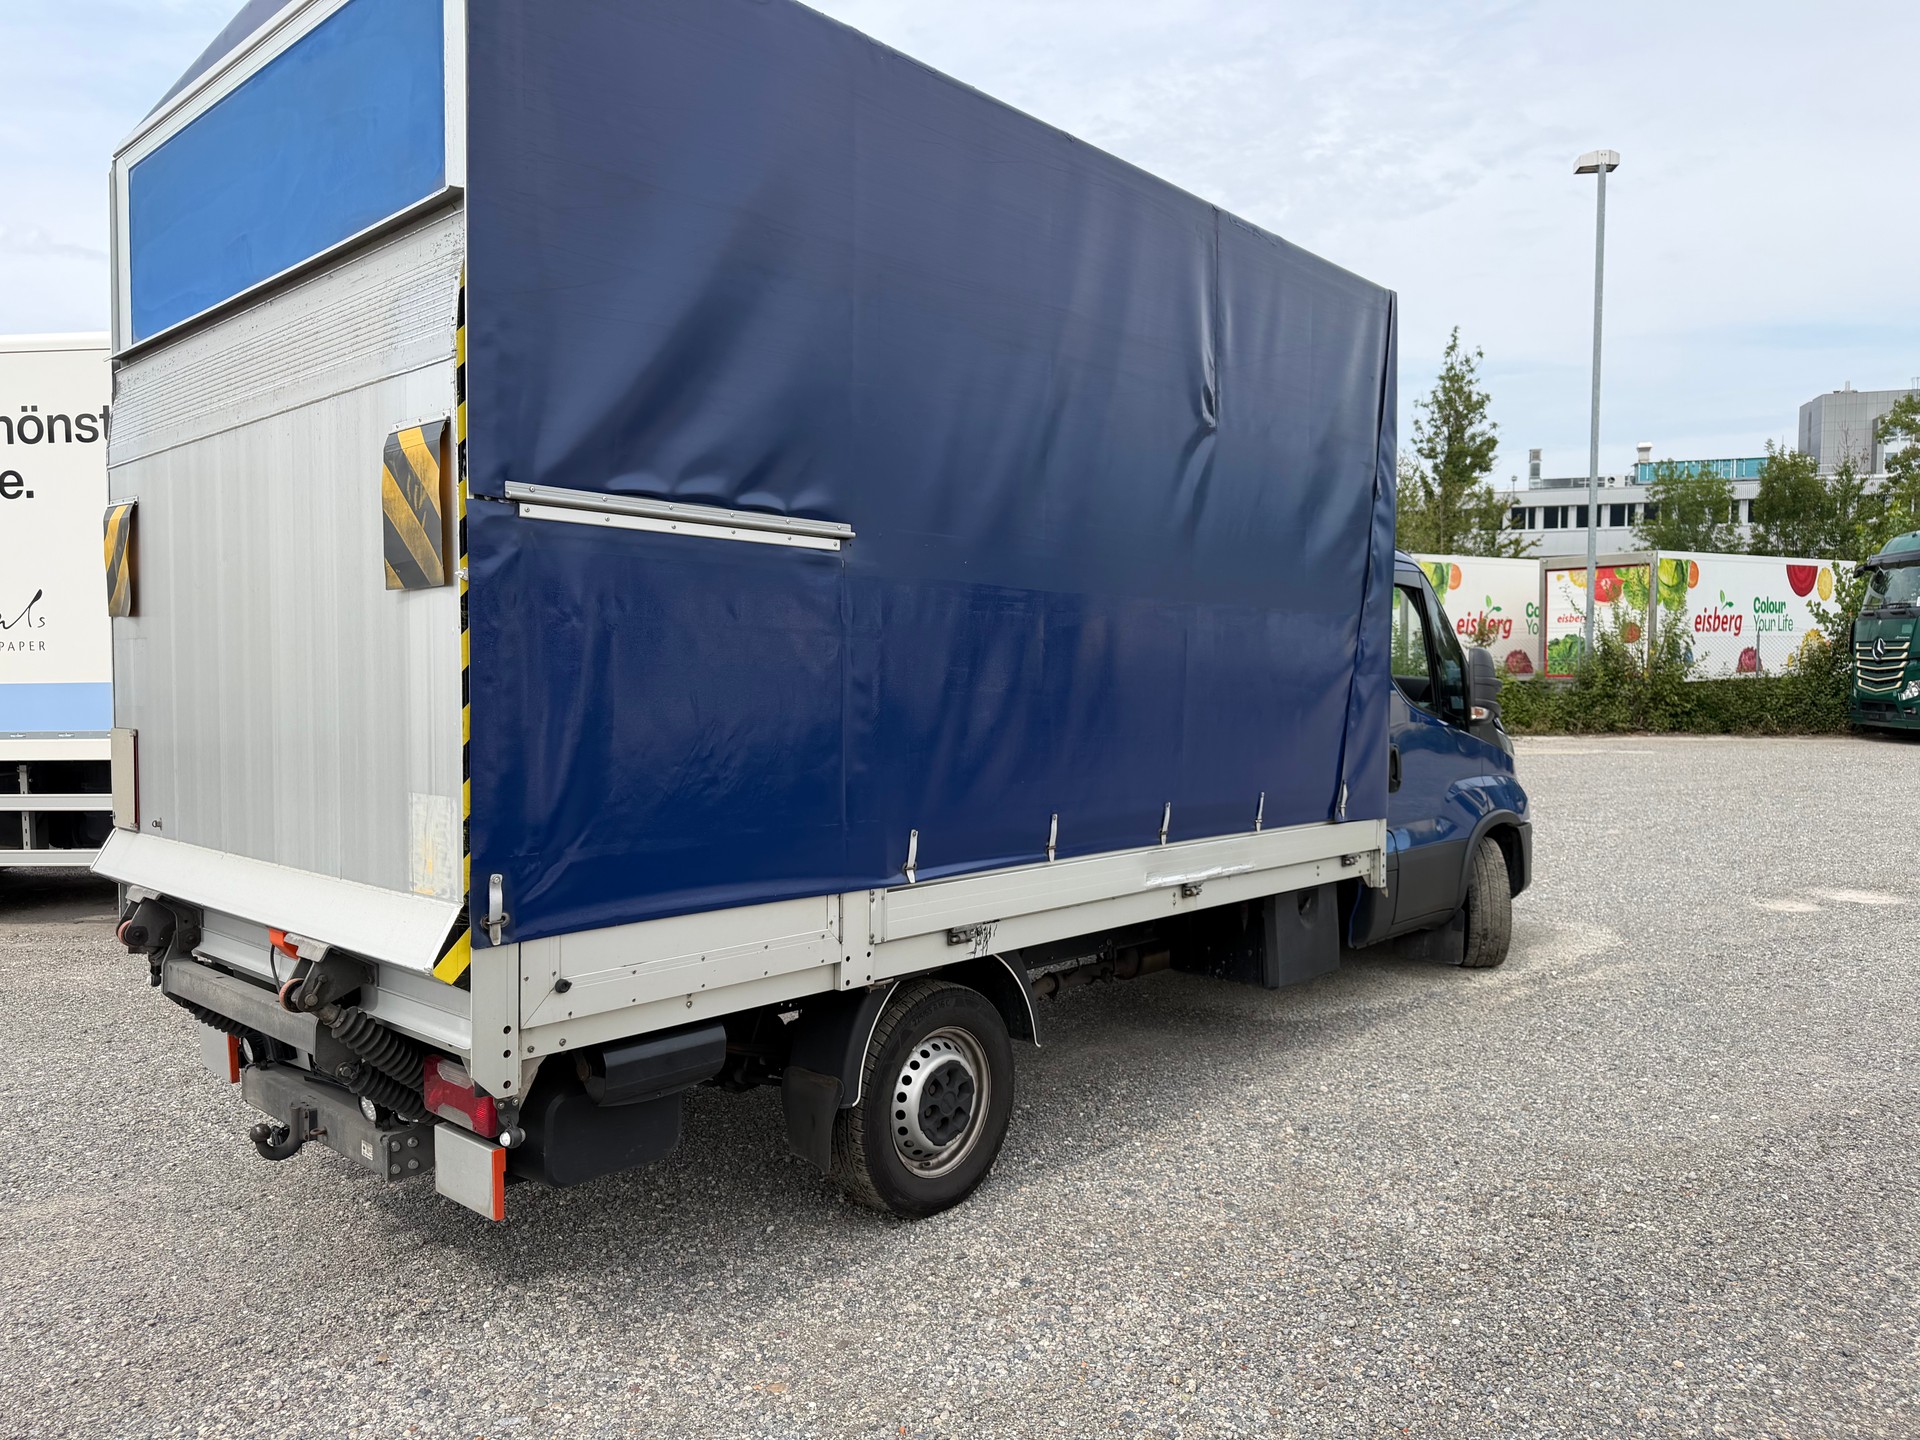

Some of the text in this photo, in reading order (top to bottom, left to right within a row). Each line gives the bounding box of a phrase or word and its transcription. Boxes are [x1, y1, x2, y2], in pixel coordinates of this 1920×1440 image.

[1753, 596, 1786, 613] Colour
[1456, 610, 1512, 639] eiserg
[1695, 606, 1743, 637] eisberg
[1753, 614, 1794, 632] Your Life
